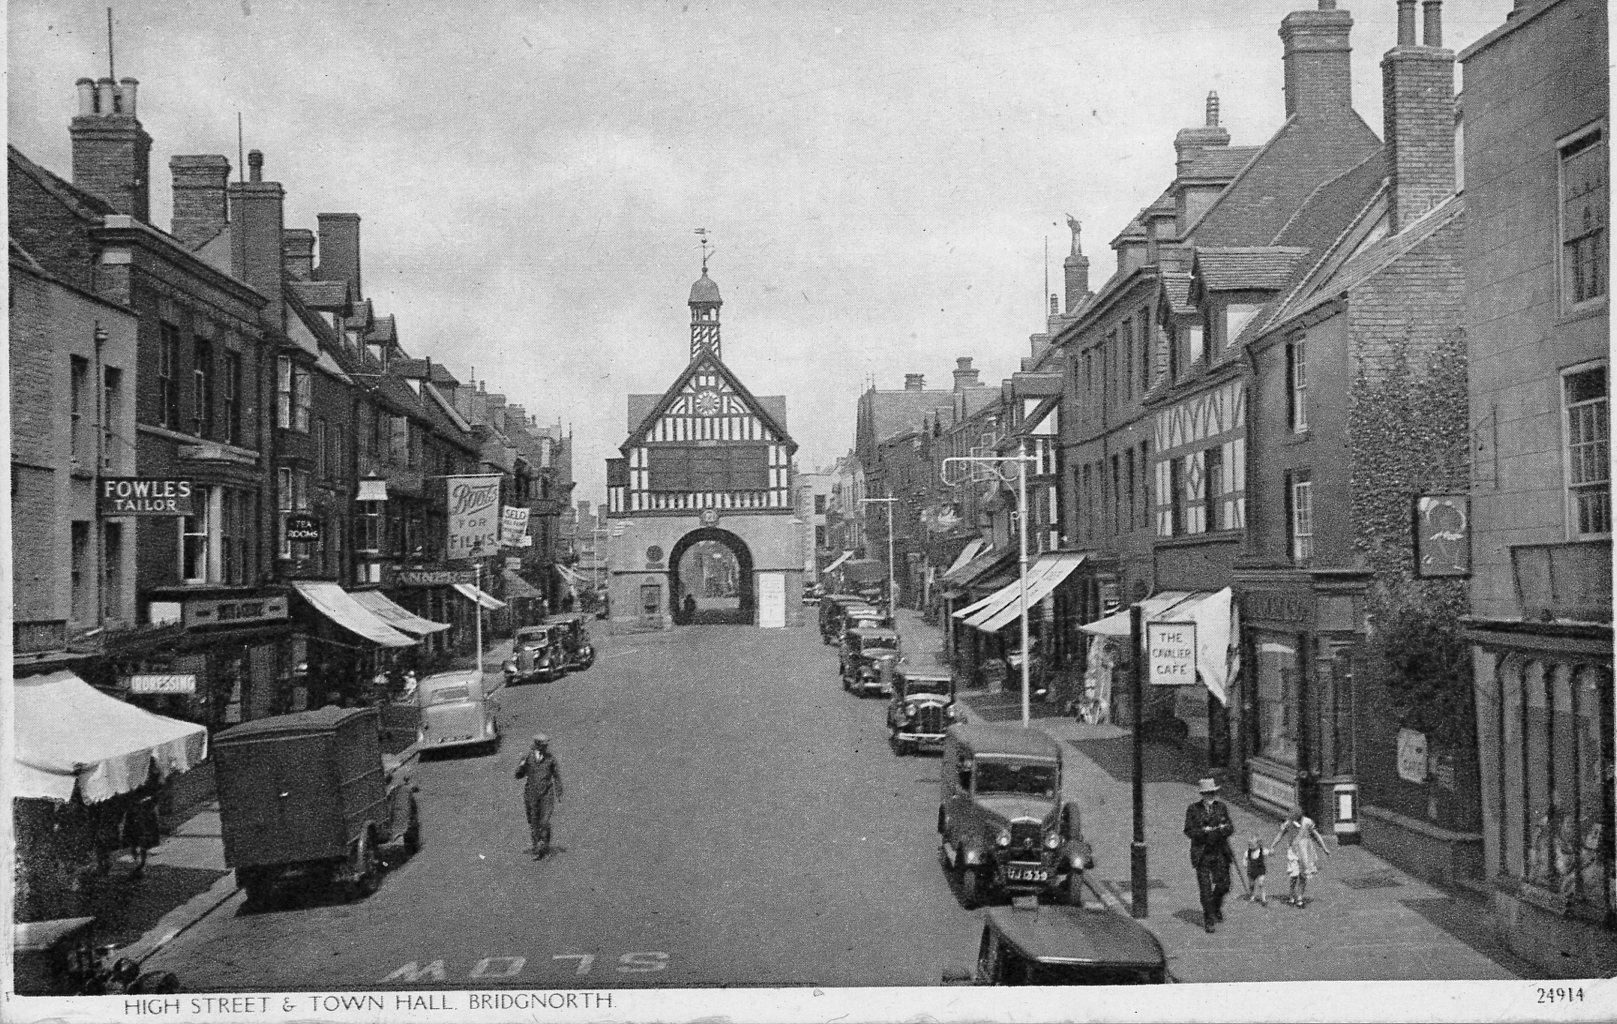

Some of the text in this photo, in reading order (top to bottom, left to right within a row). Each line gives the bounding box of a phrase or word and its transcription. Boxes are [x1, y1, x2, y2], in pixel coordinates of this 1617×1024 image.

[104, 480, 191, 498] FOWLES
[114, 499, 177, 511] TAILOR
[449, 483, 498, 516] Boots
[296, 520, 311, 529] TEA
[458, 518, 487, 528] FOR
[288, 530, 318, 538] ROOMS
[1159, 632, 1182, 643] THE
[1152, 648, 1191, 659] CAVALIER
